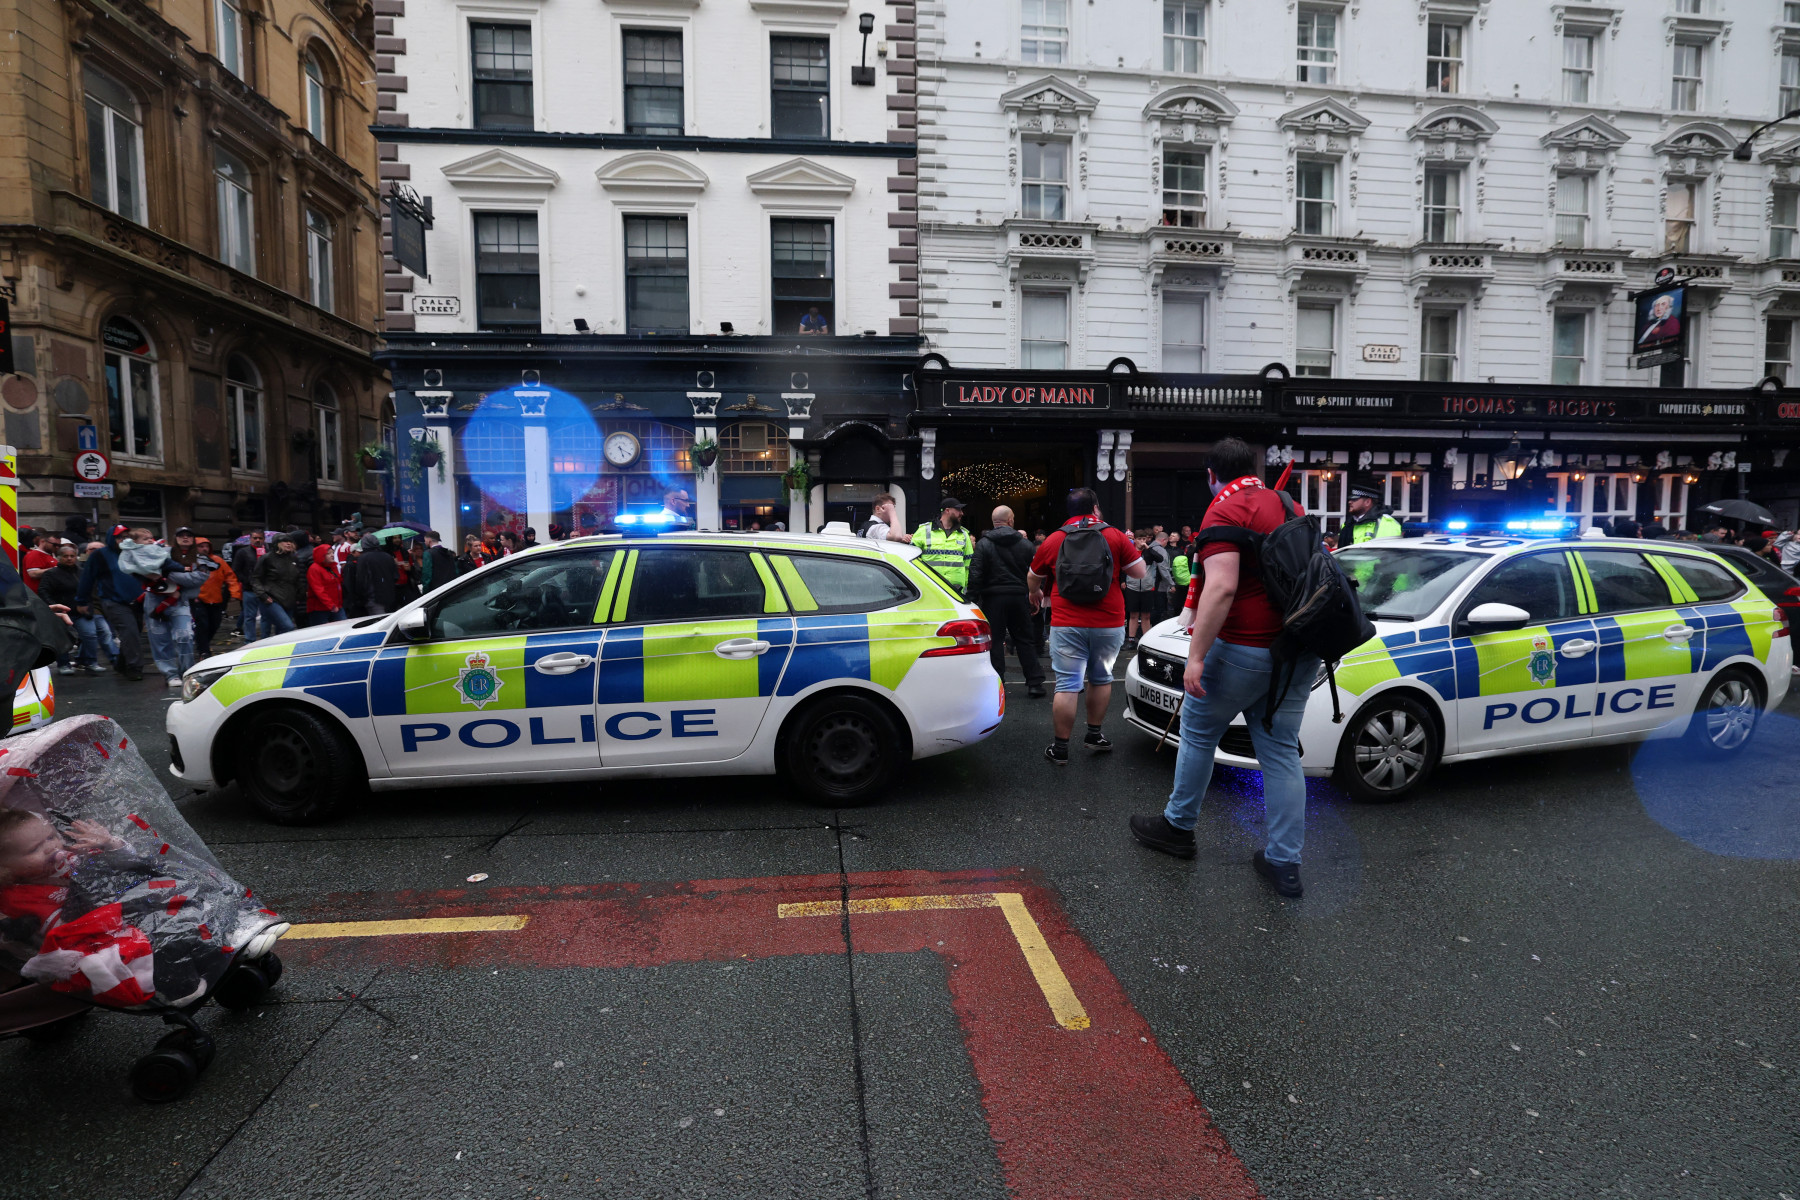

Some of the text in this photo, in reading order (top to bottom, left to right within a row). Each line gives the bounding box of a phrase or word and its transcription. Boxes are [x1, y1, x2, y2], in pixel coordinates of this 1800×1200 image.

[421, 298, 451, 306] DALE
[958, 386, 1095, 404] LADY OF MANN
[1295, 395, 1315, 406] WINE
[1328, 396, 1353, 407] SPIRIT
[1355, 397, 1394, 407] MERCHANT
[1442, 396, 1516, 415] THOMAS
[1548, 399, 1617, 417] RIGBY'S
[1659, 403, 1701, 414] IMPORTERS
[1713, 404, 1745, 415] BONDERS
[401, 494, 416, 503] EAL
[401, 505, 416, 514] LES
[470, 678, 488, 691] ER
[1140, 684, 1161, 705] DK68
[1482, 684, 1677, 731] POLICE
[400, 708, 719, 752] POLICE
